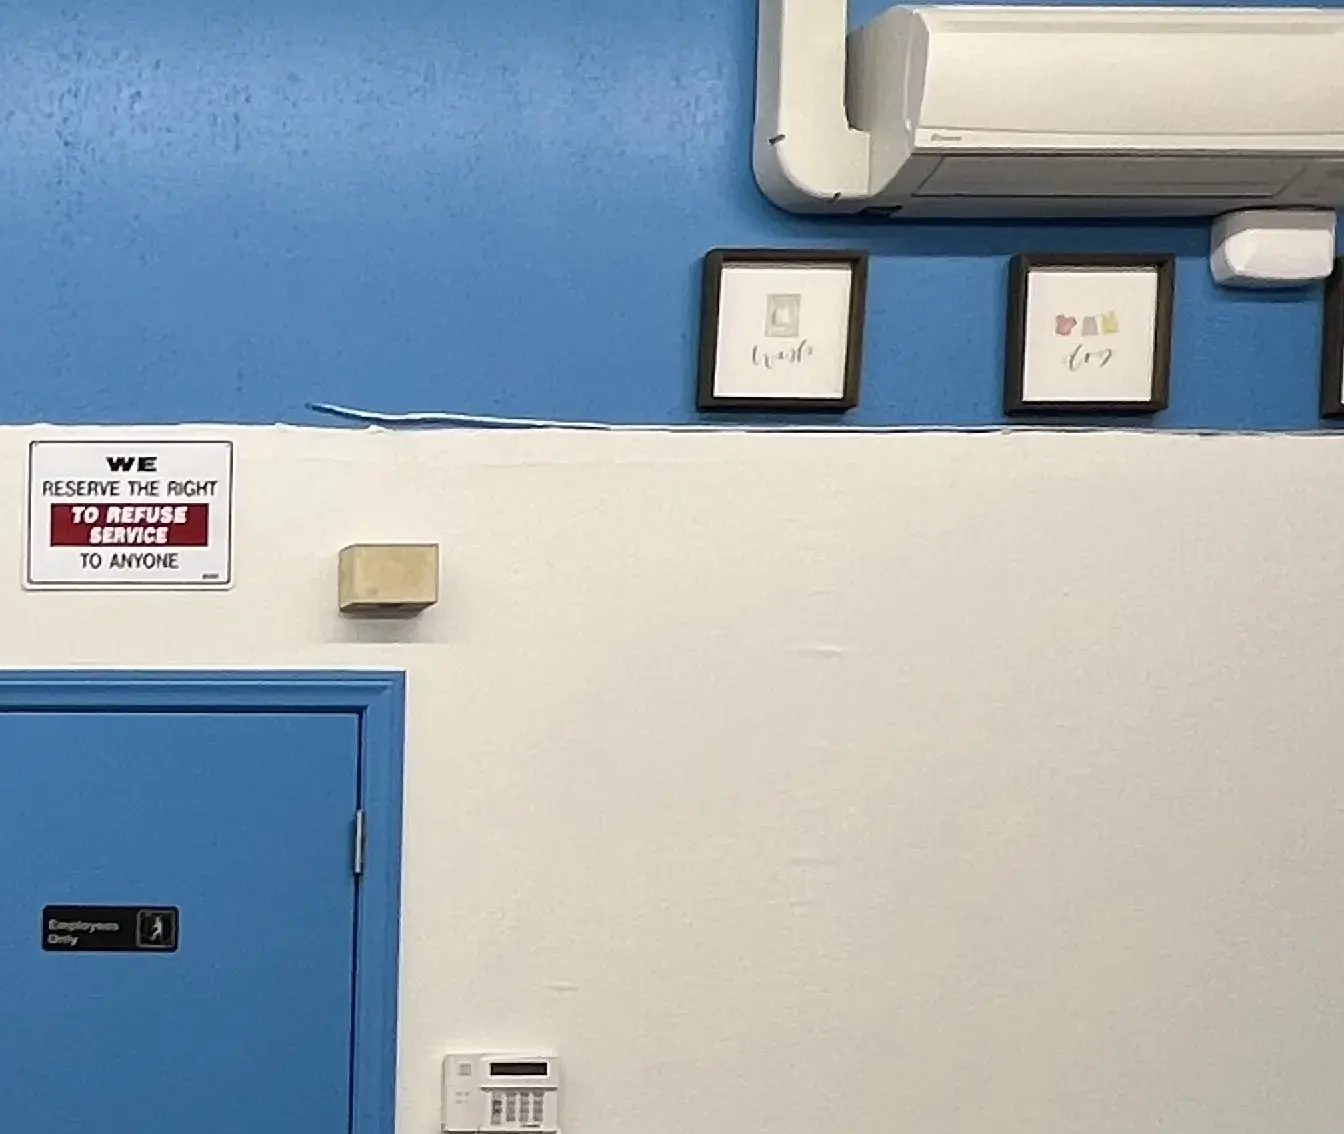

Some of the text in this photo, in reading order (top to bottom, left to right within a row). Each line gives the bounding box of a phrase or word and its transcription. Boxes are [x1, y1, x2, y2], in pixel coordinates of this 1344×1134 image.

[106, 456, 158, 472] WE
[42, 480, 218, 497] RESERVE THE RIGHT
[71, 506, 188, 524] TO REFUSE
[89, 526, 168, 544] SERVICE
[80, 552, 179, 569] TO ANYONE
